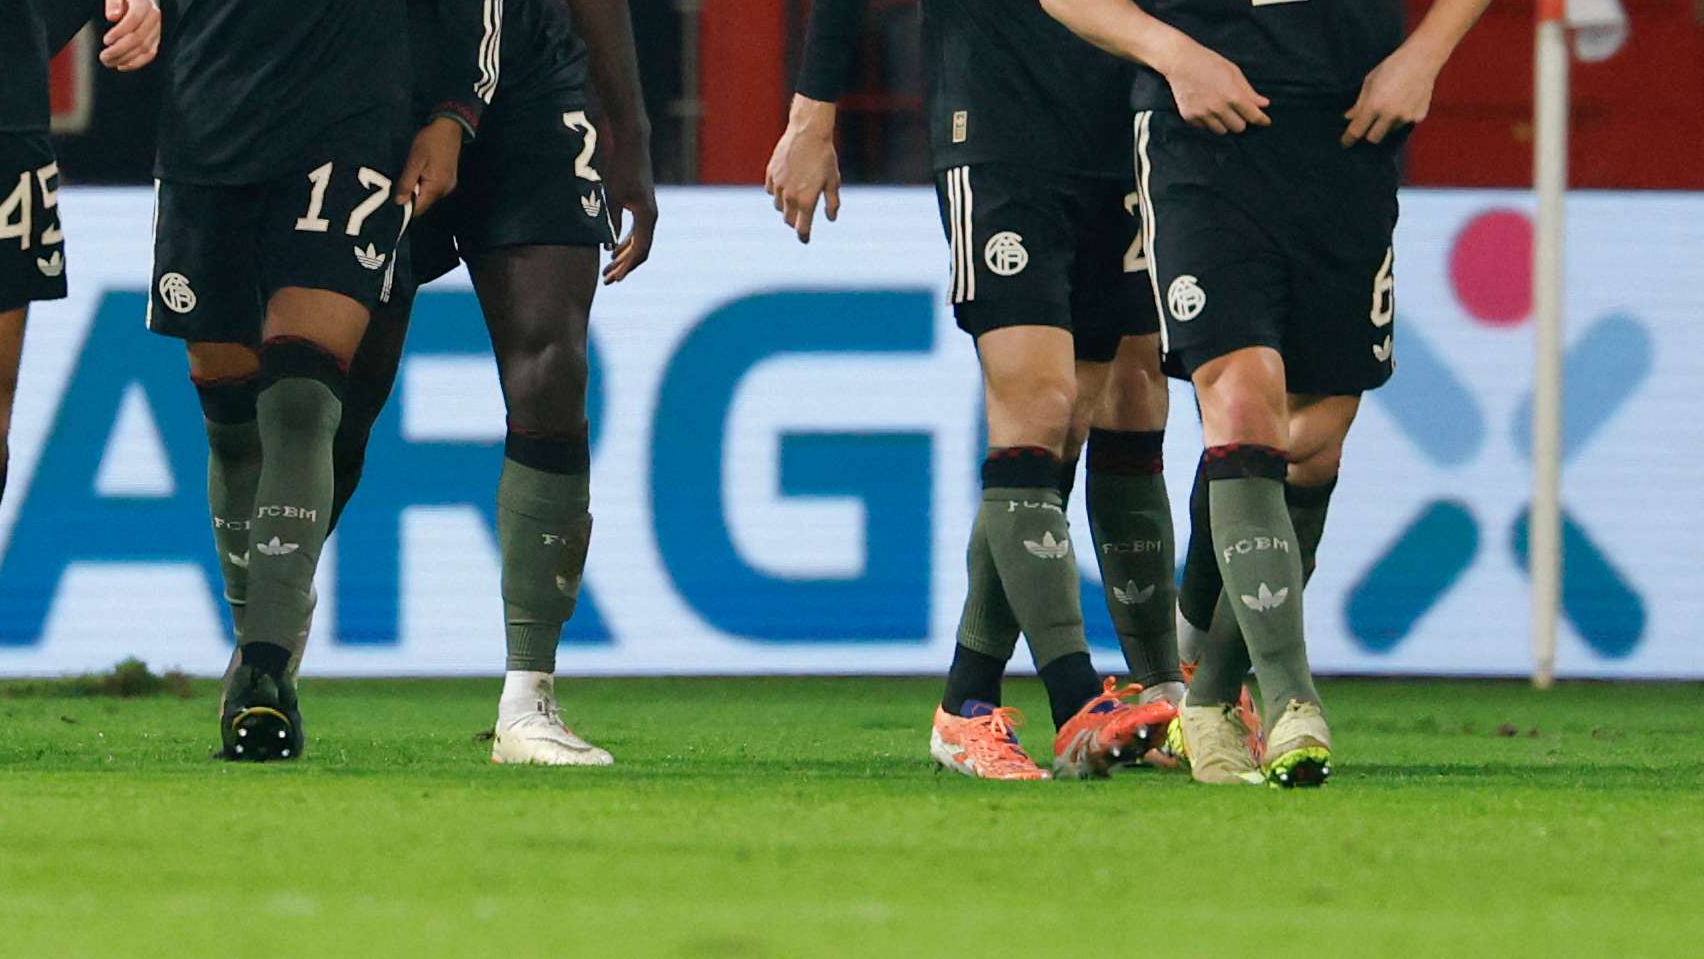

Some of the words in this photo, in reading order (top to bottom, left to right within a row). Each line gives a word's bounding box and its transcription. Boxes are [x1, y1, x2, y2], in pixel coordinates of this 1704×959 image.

[295, 161, 392, 236] 17
[257, 505, 317, 523] FCBM
[1224, 536, 1289, 564] FCBM
